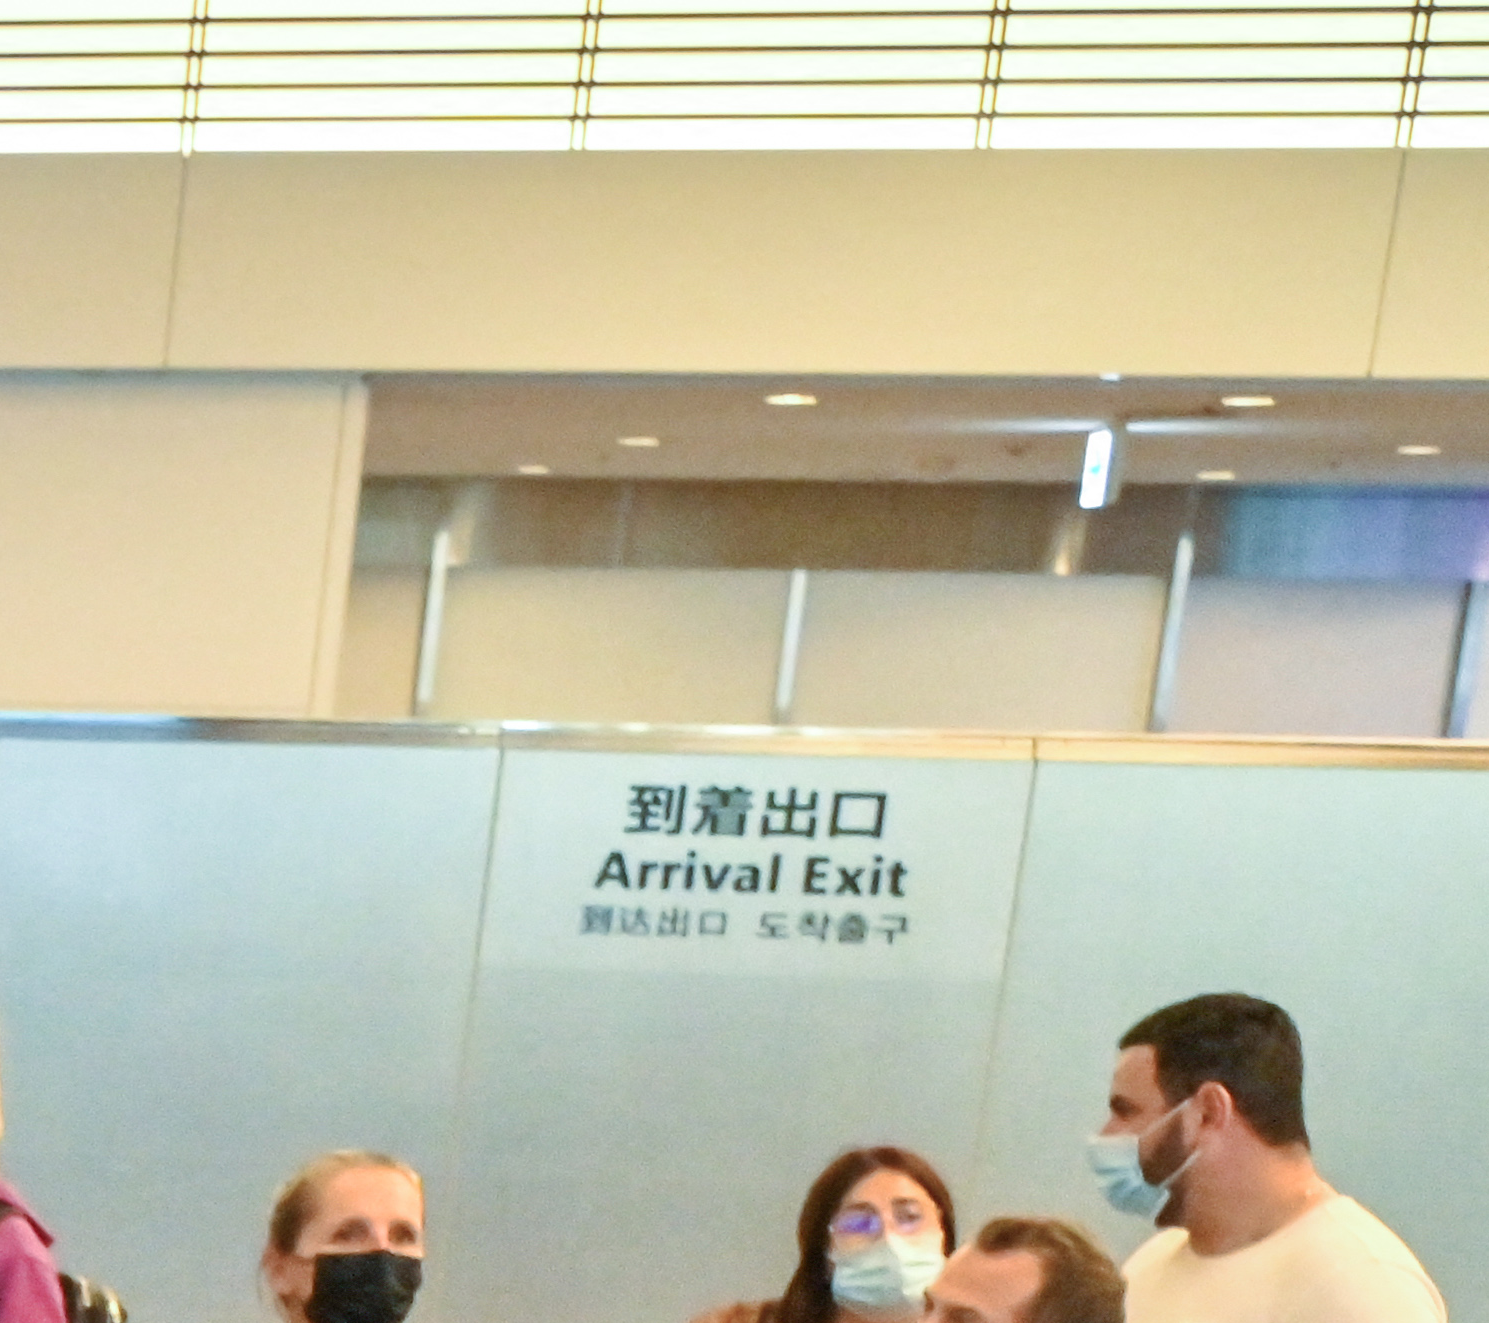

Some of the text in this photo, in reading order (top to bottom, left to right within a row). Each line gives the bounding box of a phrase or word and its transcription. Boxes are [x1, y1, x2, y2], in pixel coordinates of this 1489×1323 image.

[623, 784, 888, 838] 到着出口
[594, 851, 908, 898] Arrival Exit
